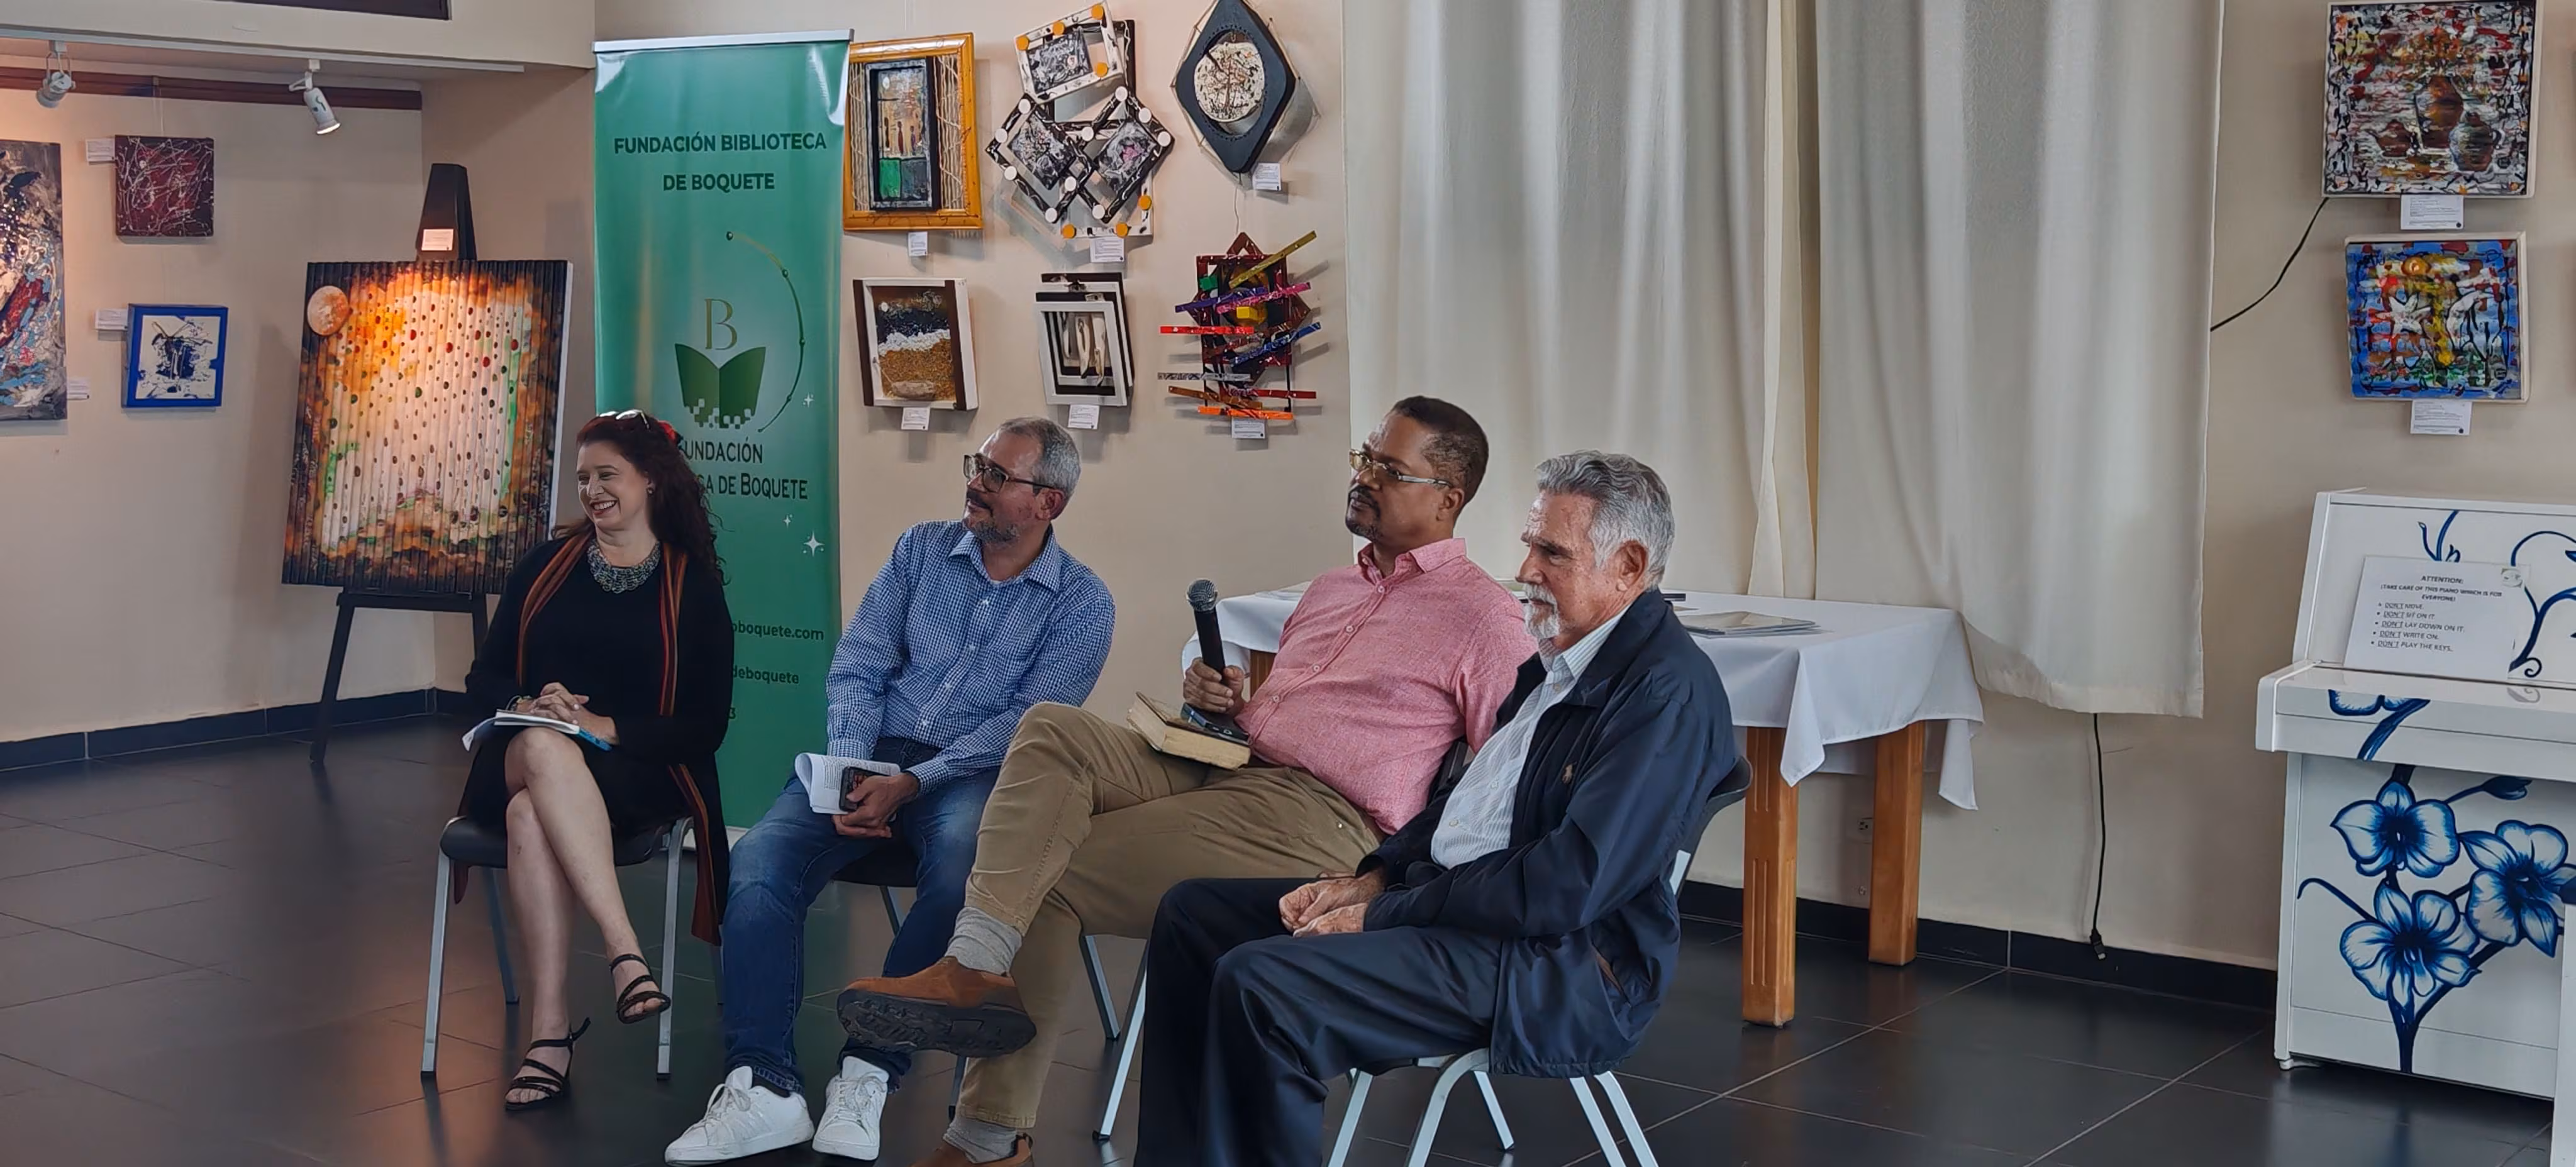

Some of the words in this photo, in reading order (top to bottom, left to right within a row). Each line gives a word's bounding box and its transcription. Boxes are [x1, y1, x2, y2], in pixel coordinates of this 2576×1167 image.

[614, 131, 716, 154] FUNDACIÓN
[721, 133, 827, 151] BIBLIOTECA
[663, 174, 687, 191] DE
[692, 173, 775, 193] BOQUETE
[704, 298, 737, 350] B
[684, 436, 763, 463] UNDACIÓN
[719, 475, 736, 495] DE
[741, 472, 808, 499] BOQUETE
[2421, 575, 2464, 584] ATTENTION:
